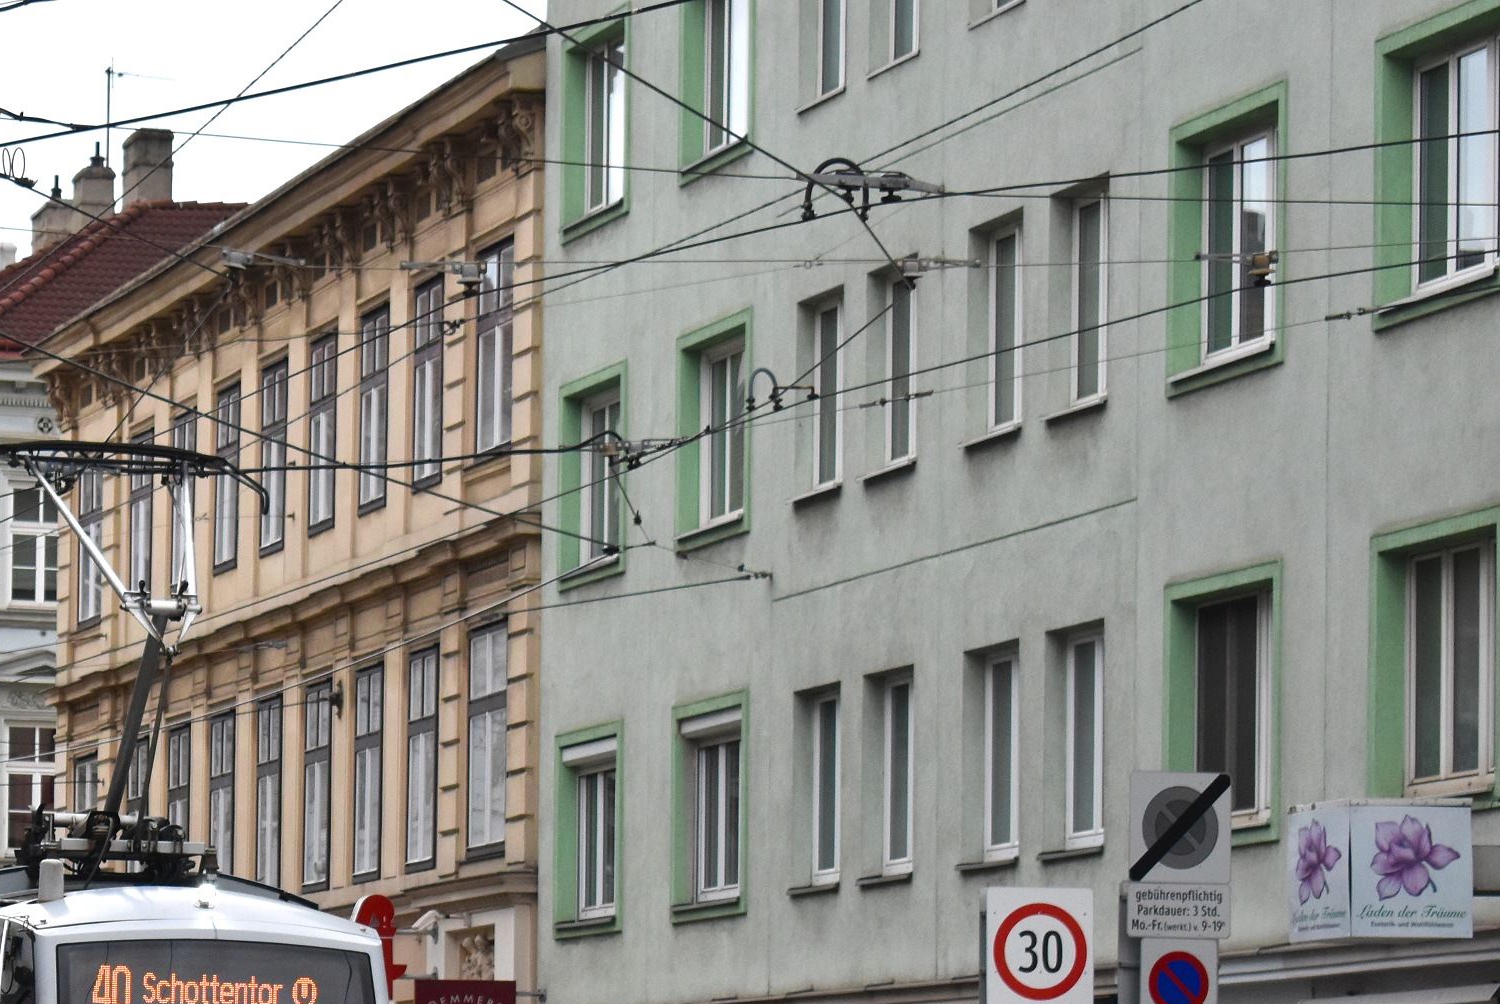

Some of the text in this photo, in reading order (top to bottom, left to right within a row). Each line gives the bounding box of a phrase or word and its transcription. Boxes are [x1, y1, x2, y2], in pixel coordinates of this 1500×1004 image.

[1135, 889, 1223, 904] gebührenpflichtig
[1137, 904, 1220, 917] Parkdauer: 3 Std.
[1398, 905, 1417, 918] der
[1018, 930, 1063, 973] 30
